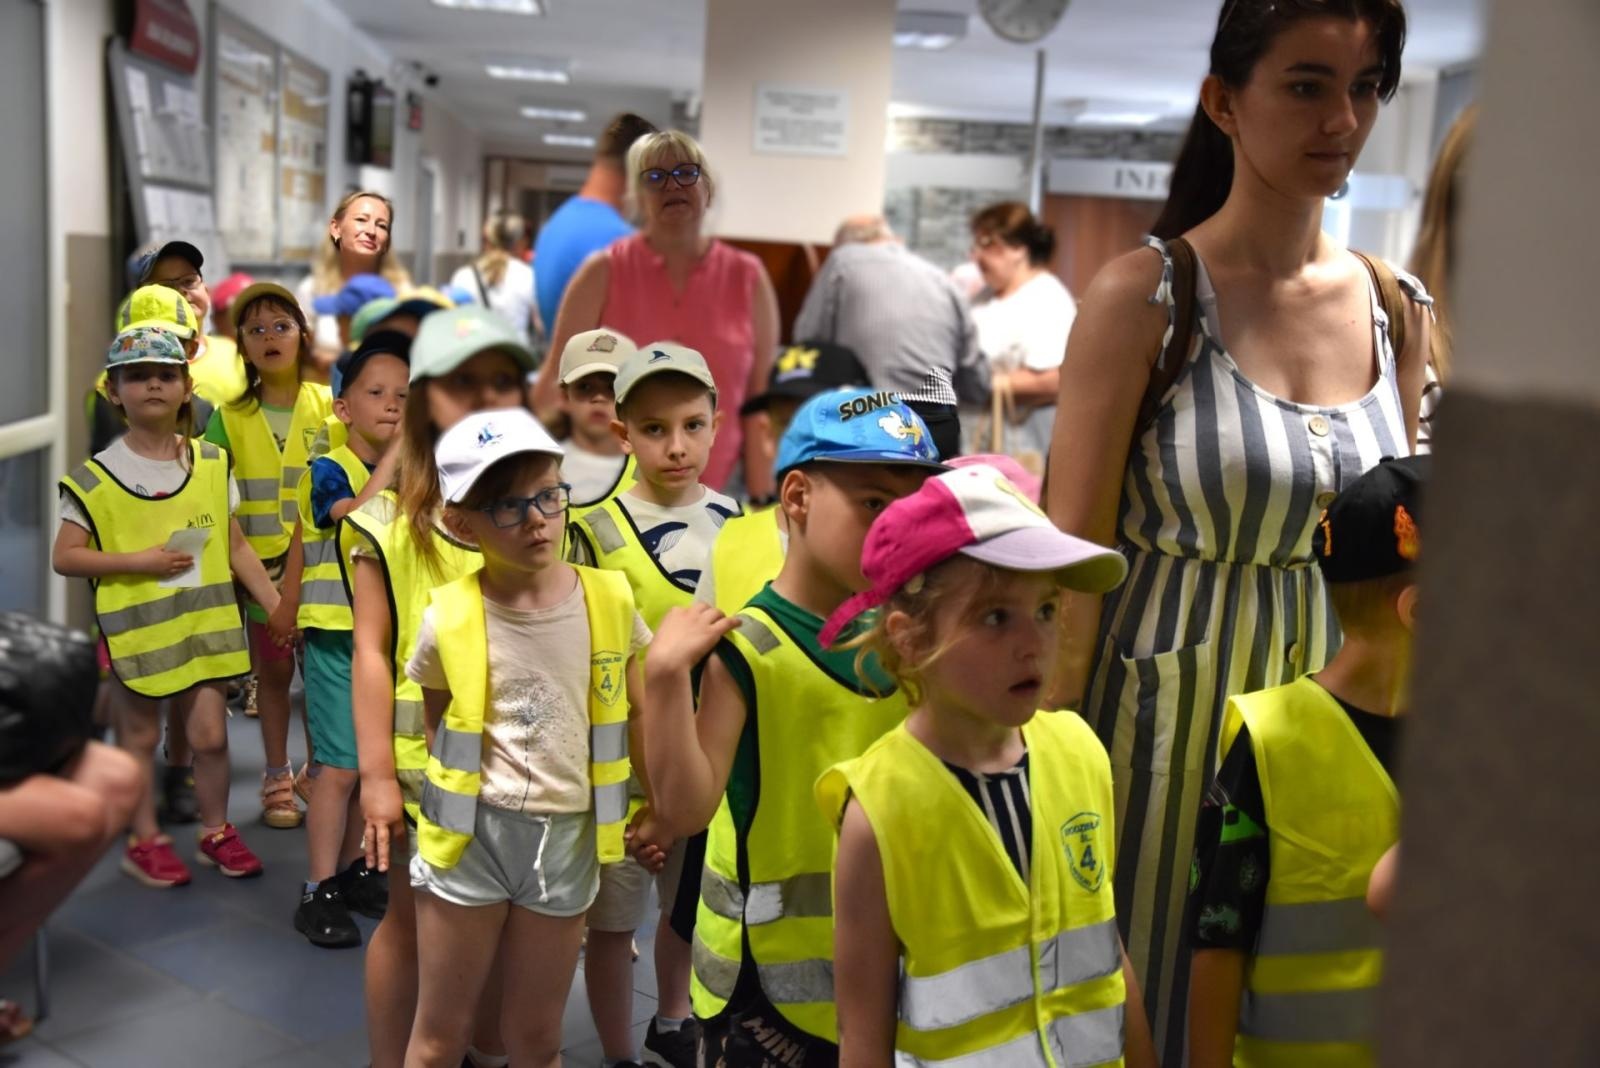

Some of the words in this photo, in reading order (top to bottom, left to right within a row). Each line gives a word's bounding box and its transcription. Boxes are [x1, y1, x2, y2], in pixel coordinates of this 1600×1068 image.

[839, 391, 899, 423] SONIC
[600, 672, 613, 692] 4
[1080, 844, 1097, 872] 4
